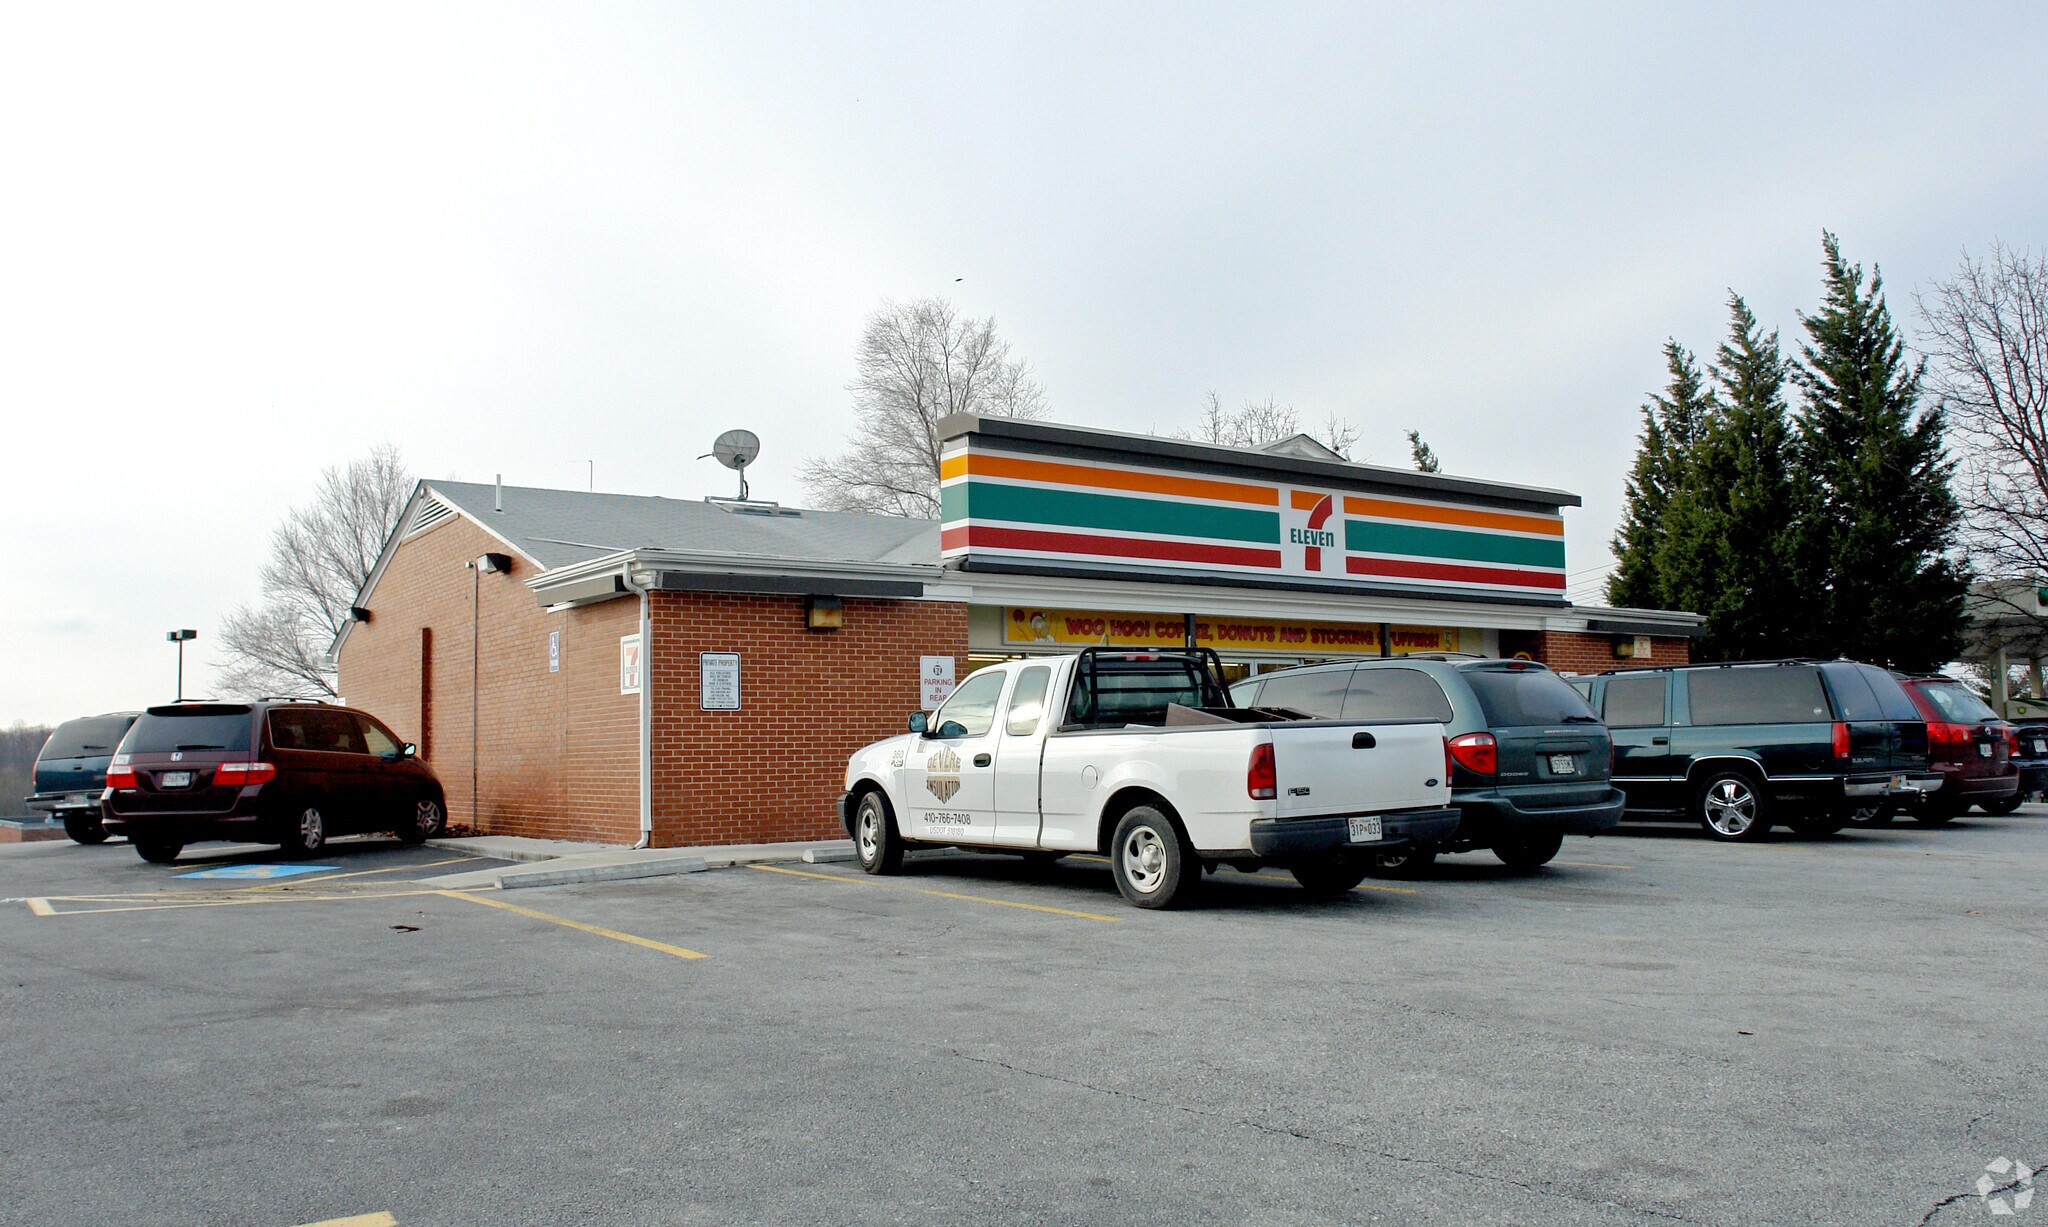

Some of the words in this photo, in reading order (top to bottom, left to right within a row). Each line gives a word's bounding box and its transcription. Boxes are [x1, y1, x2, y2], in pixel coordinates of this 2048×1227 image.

[1065, 617, 1105, 635] WOO
[1110, 619, 1150, 637] HOO!
[1155, 621, 1213, 641] COFEE,
[1218, 624, 1275, 642] DONUTS
[1279, 627, 1307, 643] AND
[1311, 628, 1374, 645] STOCKING
[924, 679, 952, 690] PARKING
[927, 746, 961, 768] DEVERE
[924, 812, 971, 825] 410-766-7408
